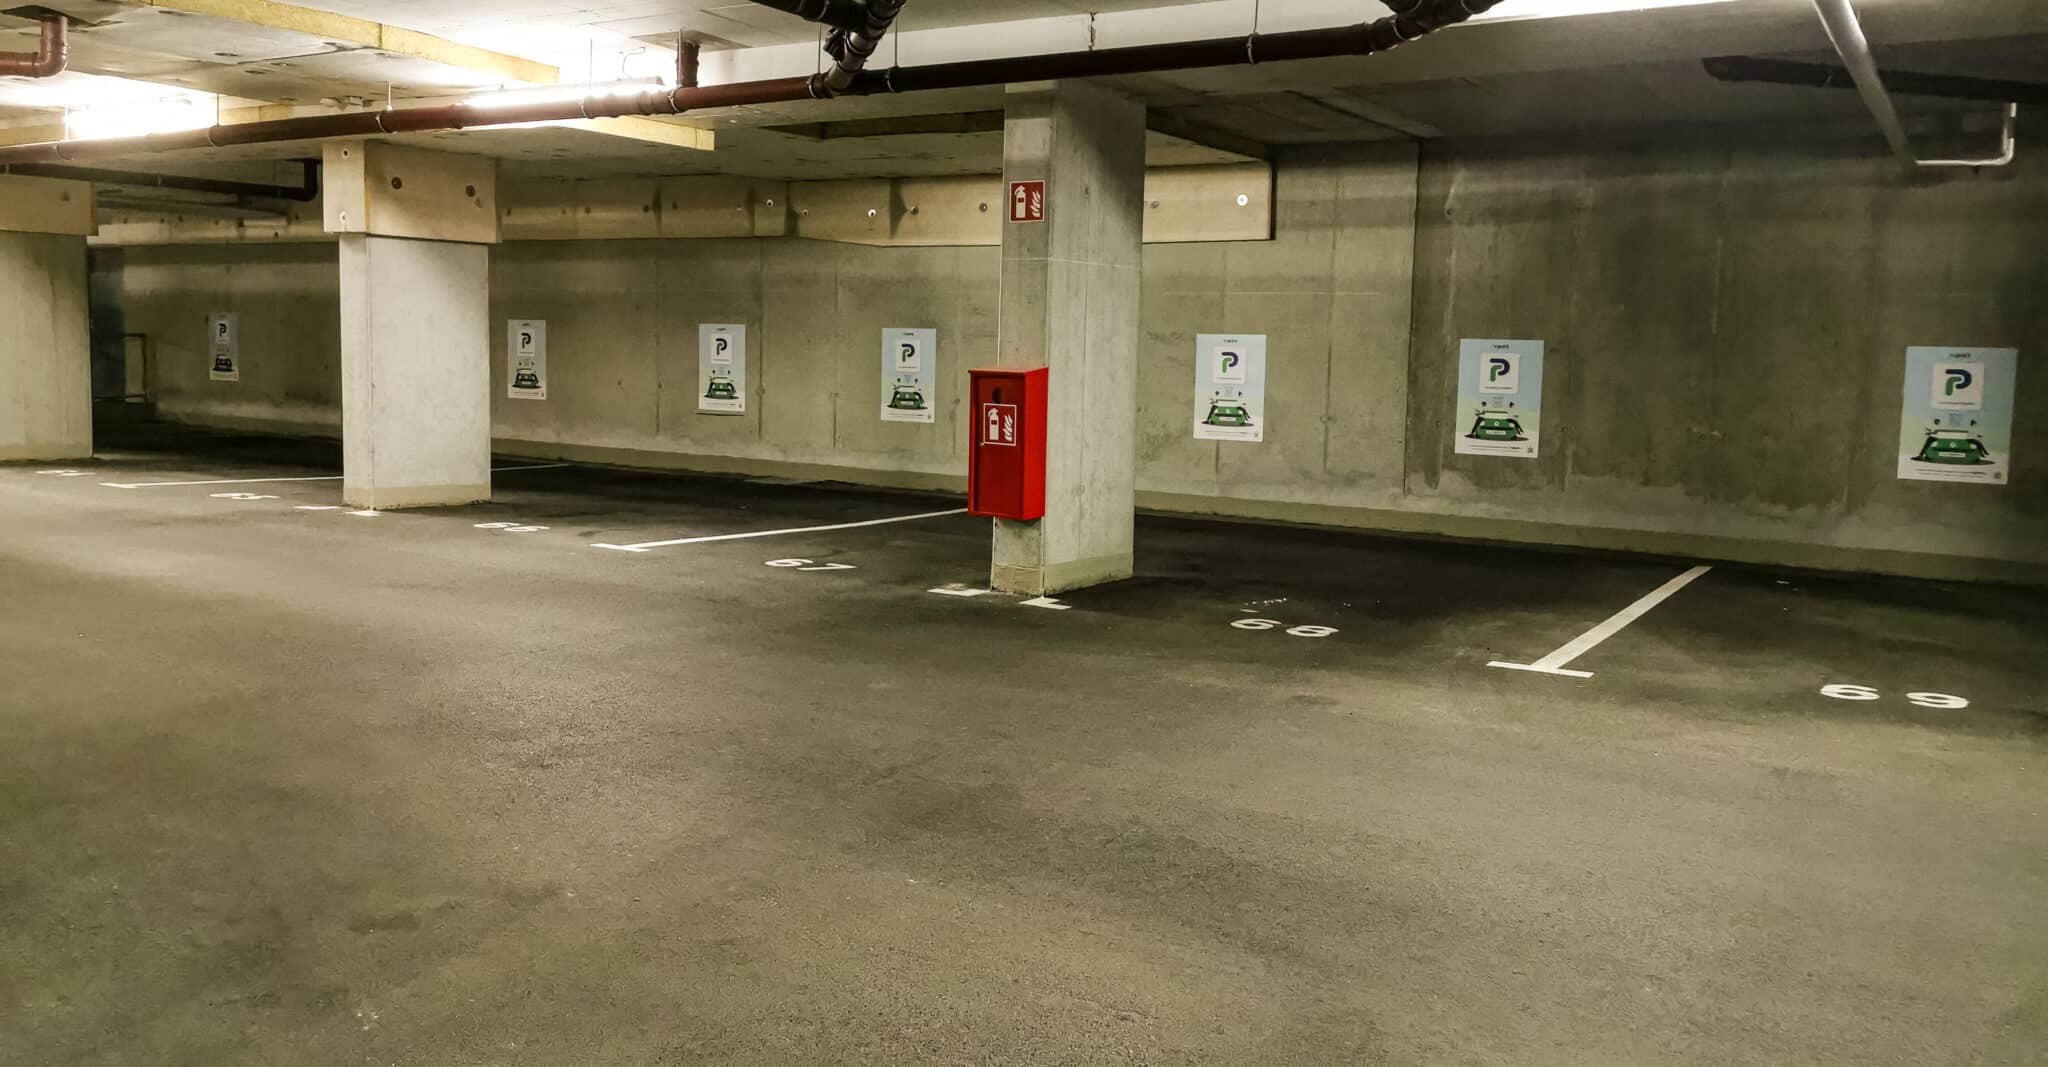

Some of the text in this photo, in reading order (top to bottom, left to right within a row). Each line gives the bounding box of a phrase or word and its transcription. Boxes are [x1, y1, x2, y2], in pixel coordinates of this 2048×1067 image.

[521, 332, 531, 349] P
[715, 338, 727, 356] P
[901, 343, 915, 363] P
[1221, 351, 1239, 374] P
[1489, 358, 1510, 382] P
[1945, 368, 1973, 396] P
[473, 522, 551, 532] 66
[764, 558, 857, 571] 67
[1230, 618, 1339, 637] 68
[1820, 684, 1969, 709] 69
